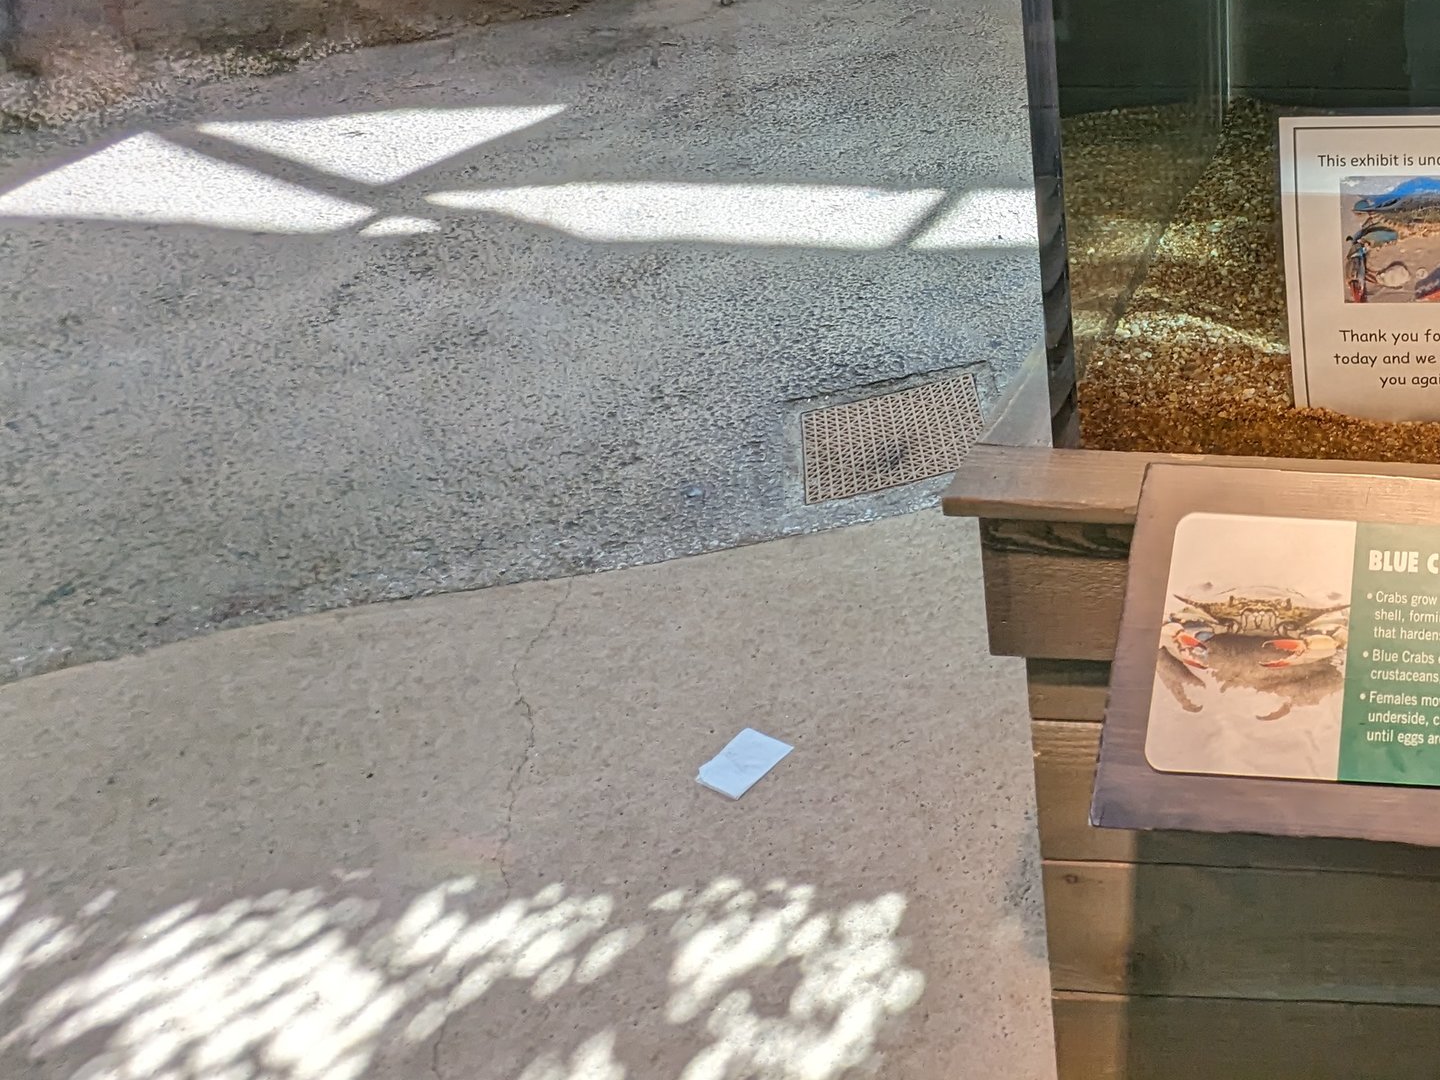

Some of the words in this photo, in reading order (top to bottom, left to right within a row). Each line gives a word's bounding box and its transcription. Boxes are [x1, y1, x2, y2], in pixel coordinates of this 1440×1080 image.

[1317, 154, 1347, 167] This
[1351, 154, 1399, 167] exhibit
[1403, 154, 1414, 166] is
[1339, 329, 1386, 342] Thank
[1392, 332, 1419, 345] you
[1334, 352, 1377, 367] today
[1383, 352, 1410, 364] and
[1415, 354, 1436, 364] we
[1380, 375, 1406, 388] you
[1368, 550, 1419, 572] BLUE
[1375, 591, 1407, 604] Crabs
[1411, 594, 1438, 606] grow
[1375, 609, 1405, 622] shell,
[1373, 627, 1396, 639] that
[1373, 649, 1399, 662] Blue
[1402, 651, 1435, 664] Crabs
[1370, 691, 1418, 706] Females
[1368, 711, 1429, 727] underside,
[1367, 729, 1394, 742] until
[1397, 732, 1424, 746] eggs
